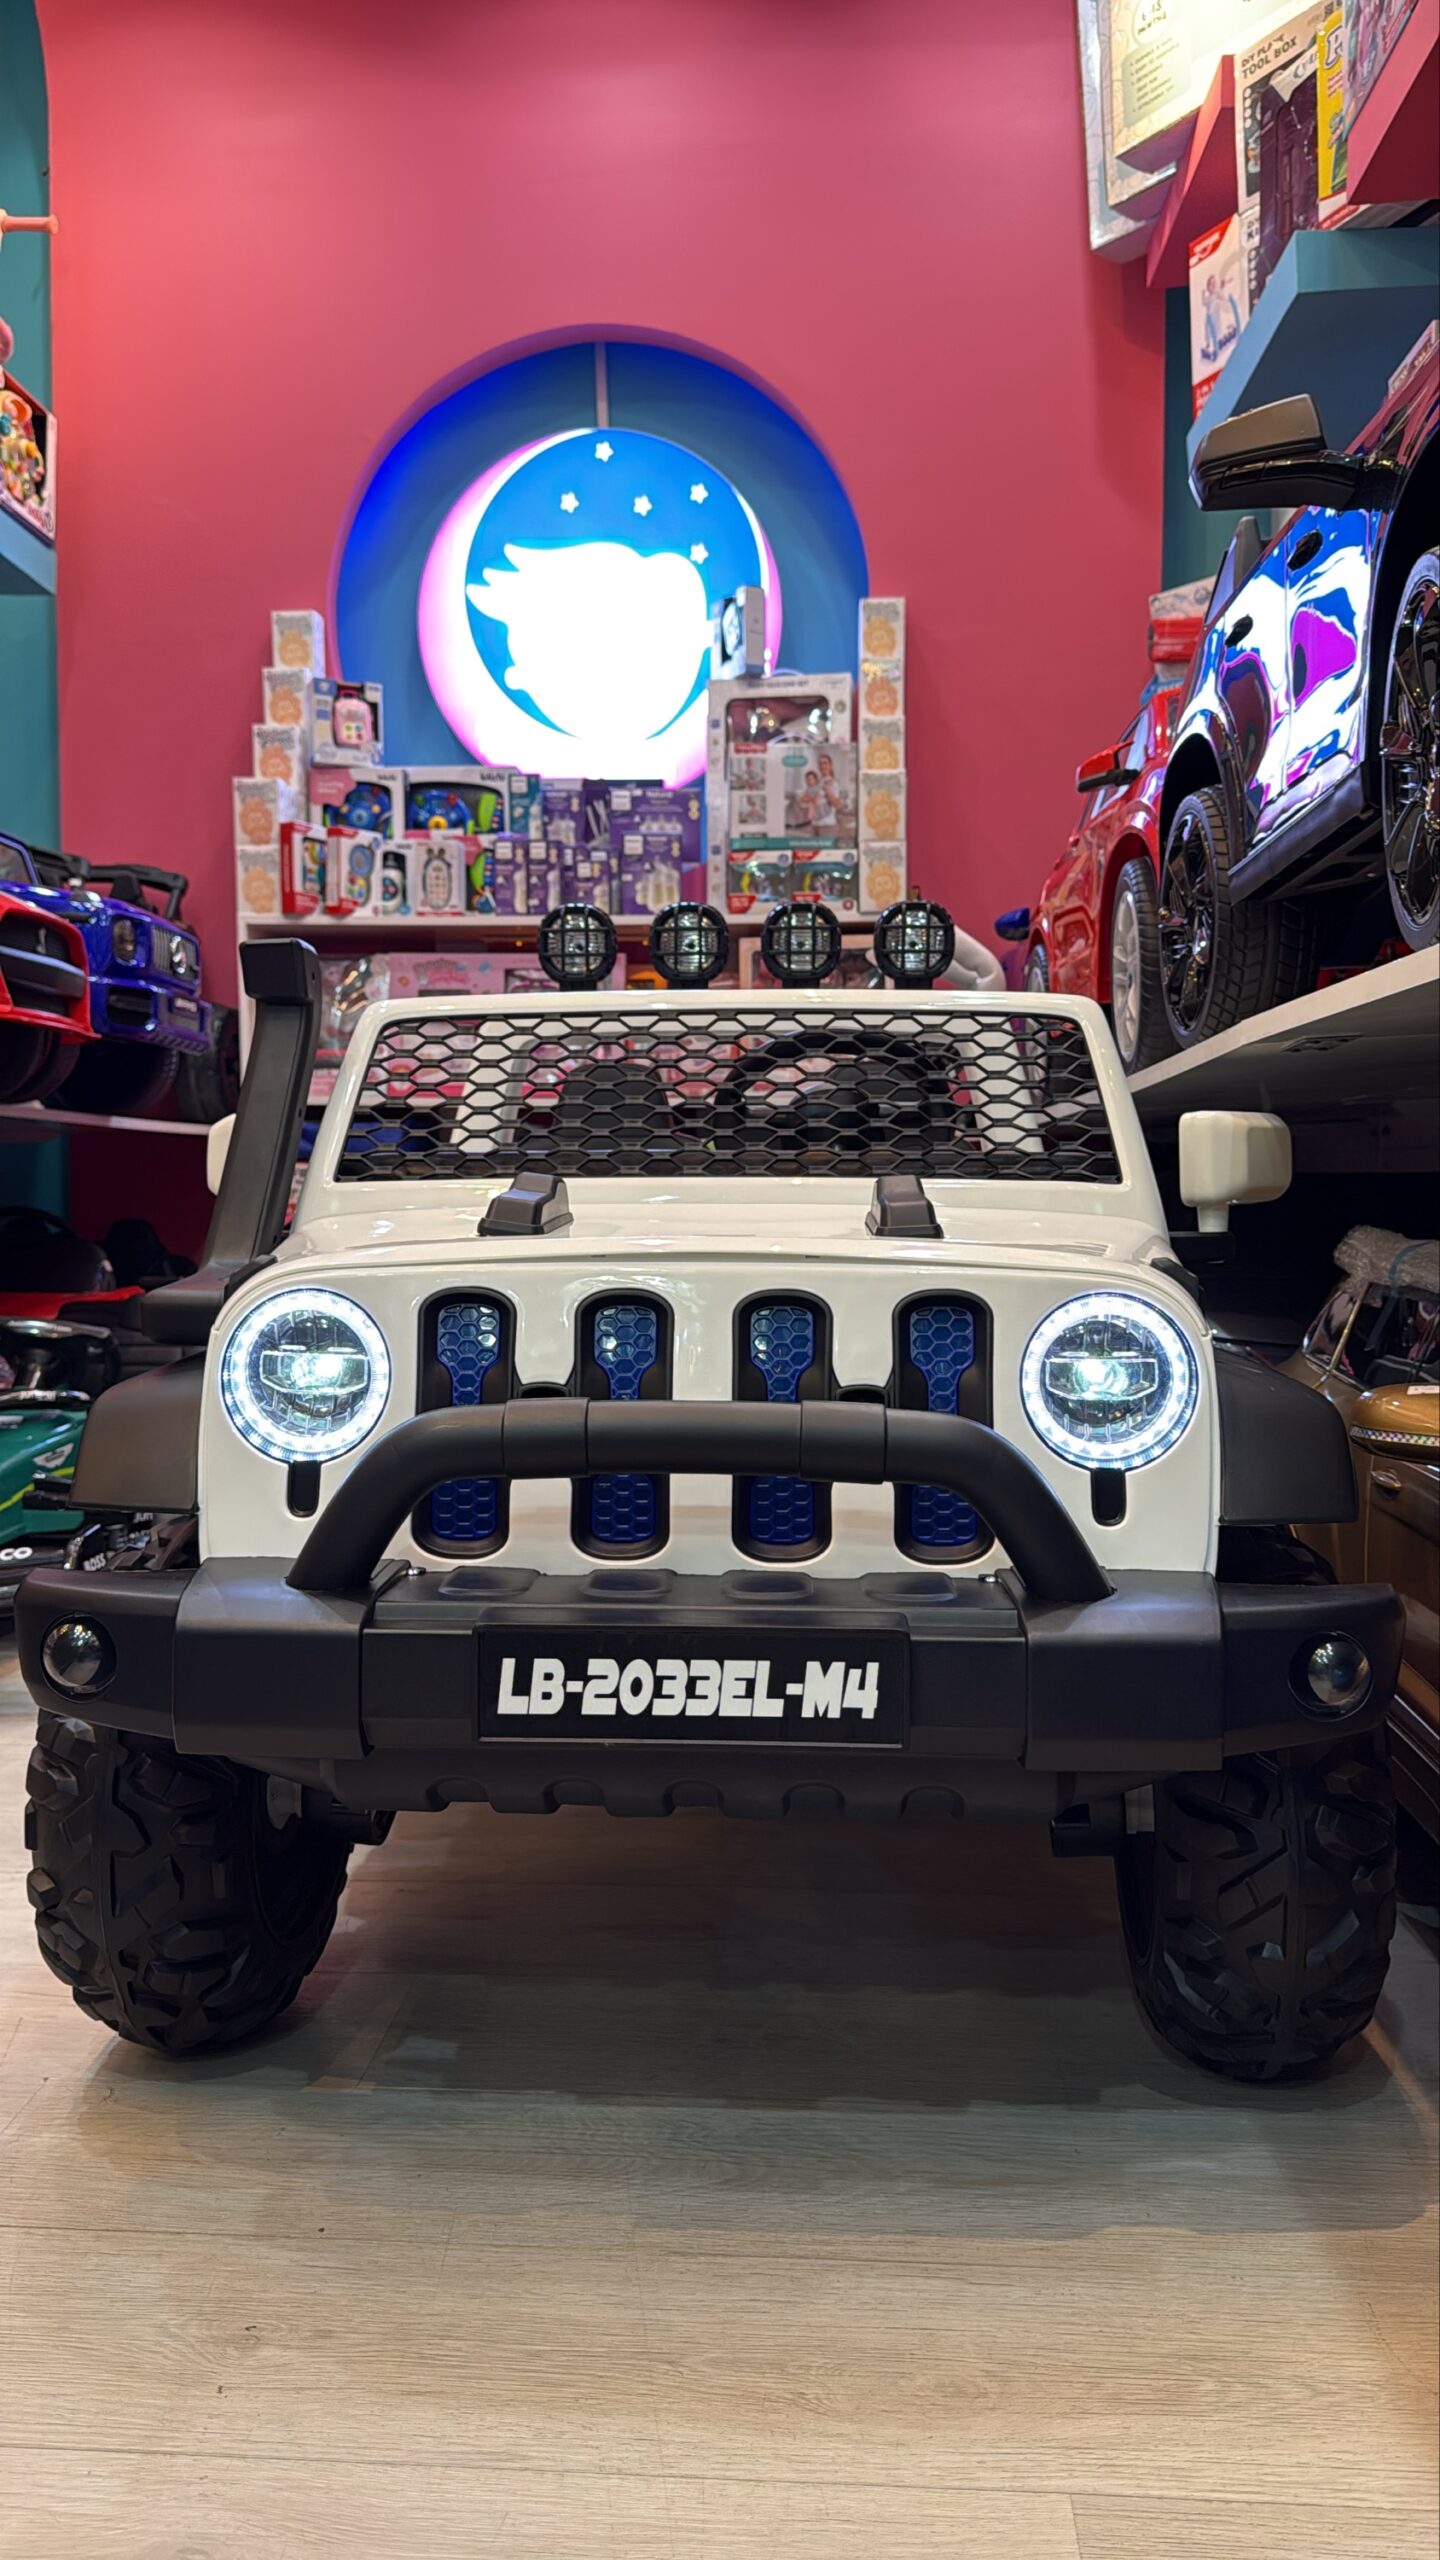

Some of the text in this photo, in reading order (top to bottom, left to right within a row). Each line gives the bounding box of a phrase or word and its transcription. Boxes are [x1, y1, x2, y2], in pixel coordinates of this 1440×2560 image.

[1242, 55, 1272, 79] TOOL
[1274, 36, 1297, 59] BOX
[497, 1657, 880, 1719] LB-2033EL-M4
